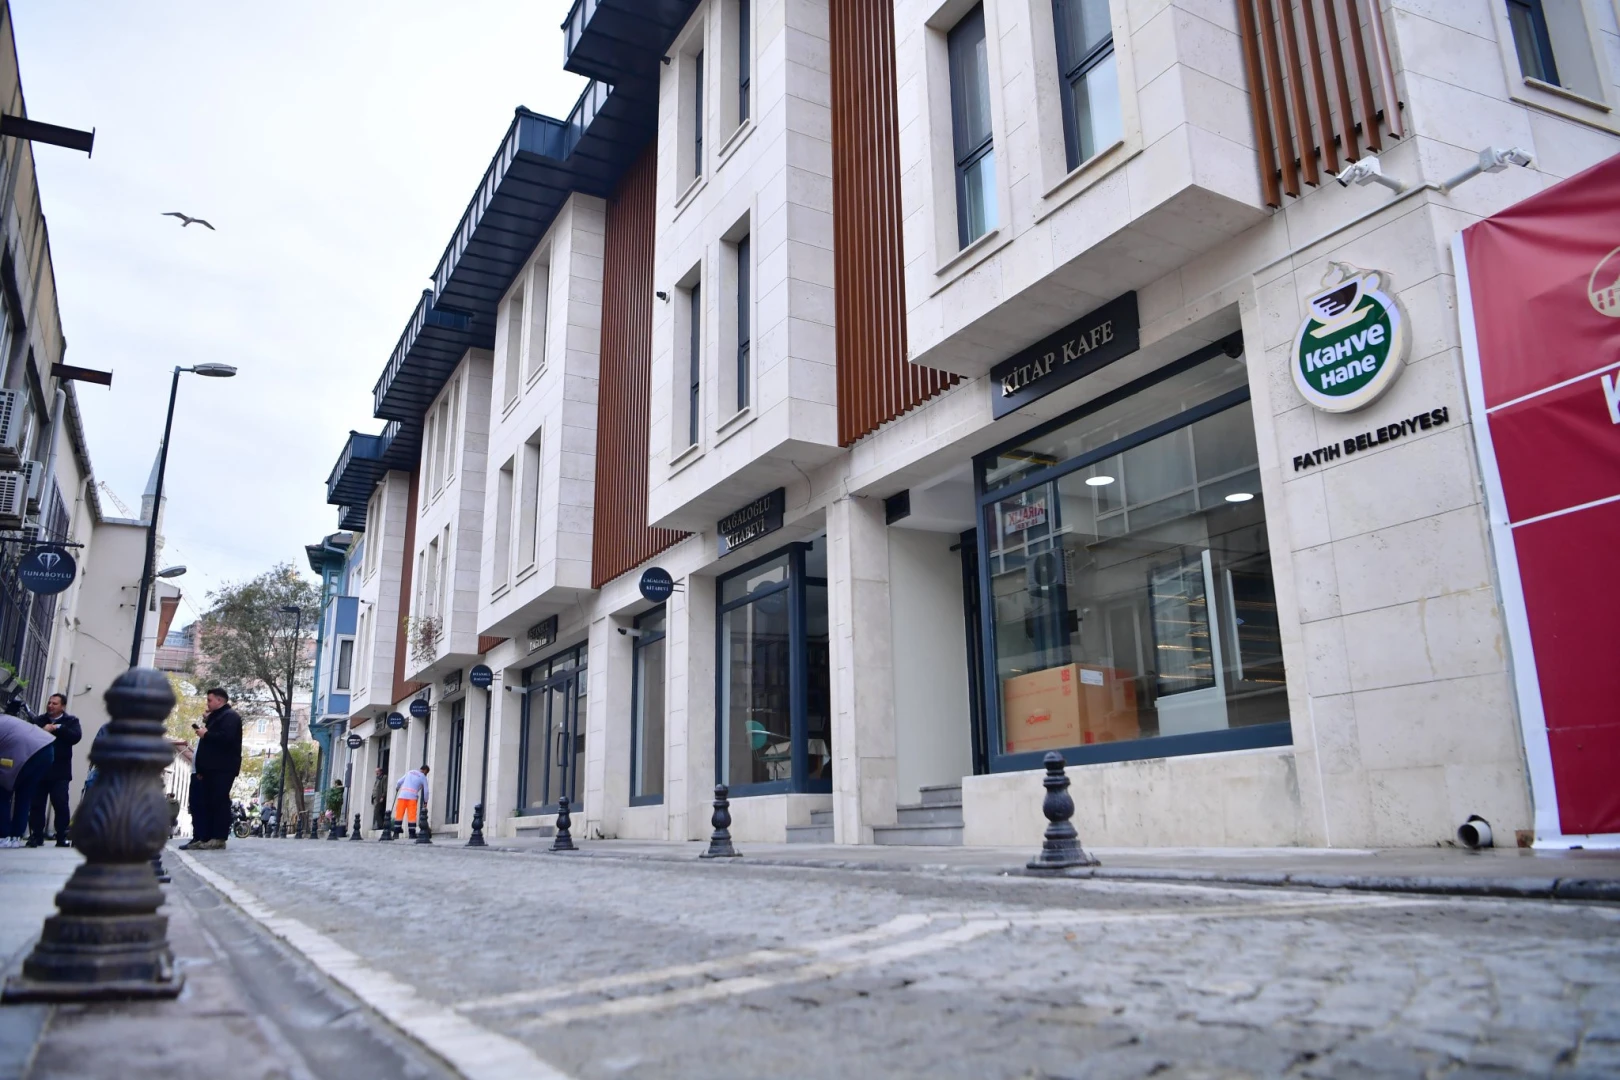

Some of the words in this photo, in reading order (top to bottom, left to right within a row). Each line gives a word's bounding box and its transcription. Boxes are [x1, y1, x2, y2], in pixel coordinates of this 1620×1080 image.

[1000, 352, 1055, 397] KİTAP
[1062, 320, 1114, 364] KAFE
[1293, 443, 1341, 472] FATİH
[1344, 406, 1449, 455] BELEDİYESİ
[725, 515, 765, 550] KİTABEVİ
[23, 570, 72, 579] TUNABOYLU
